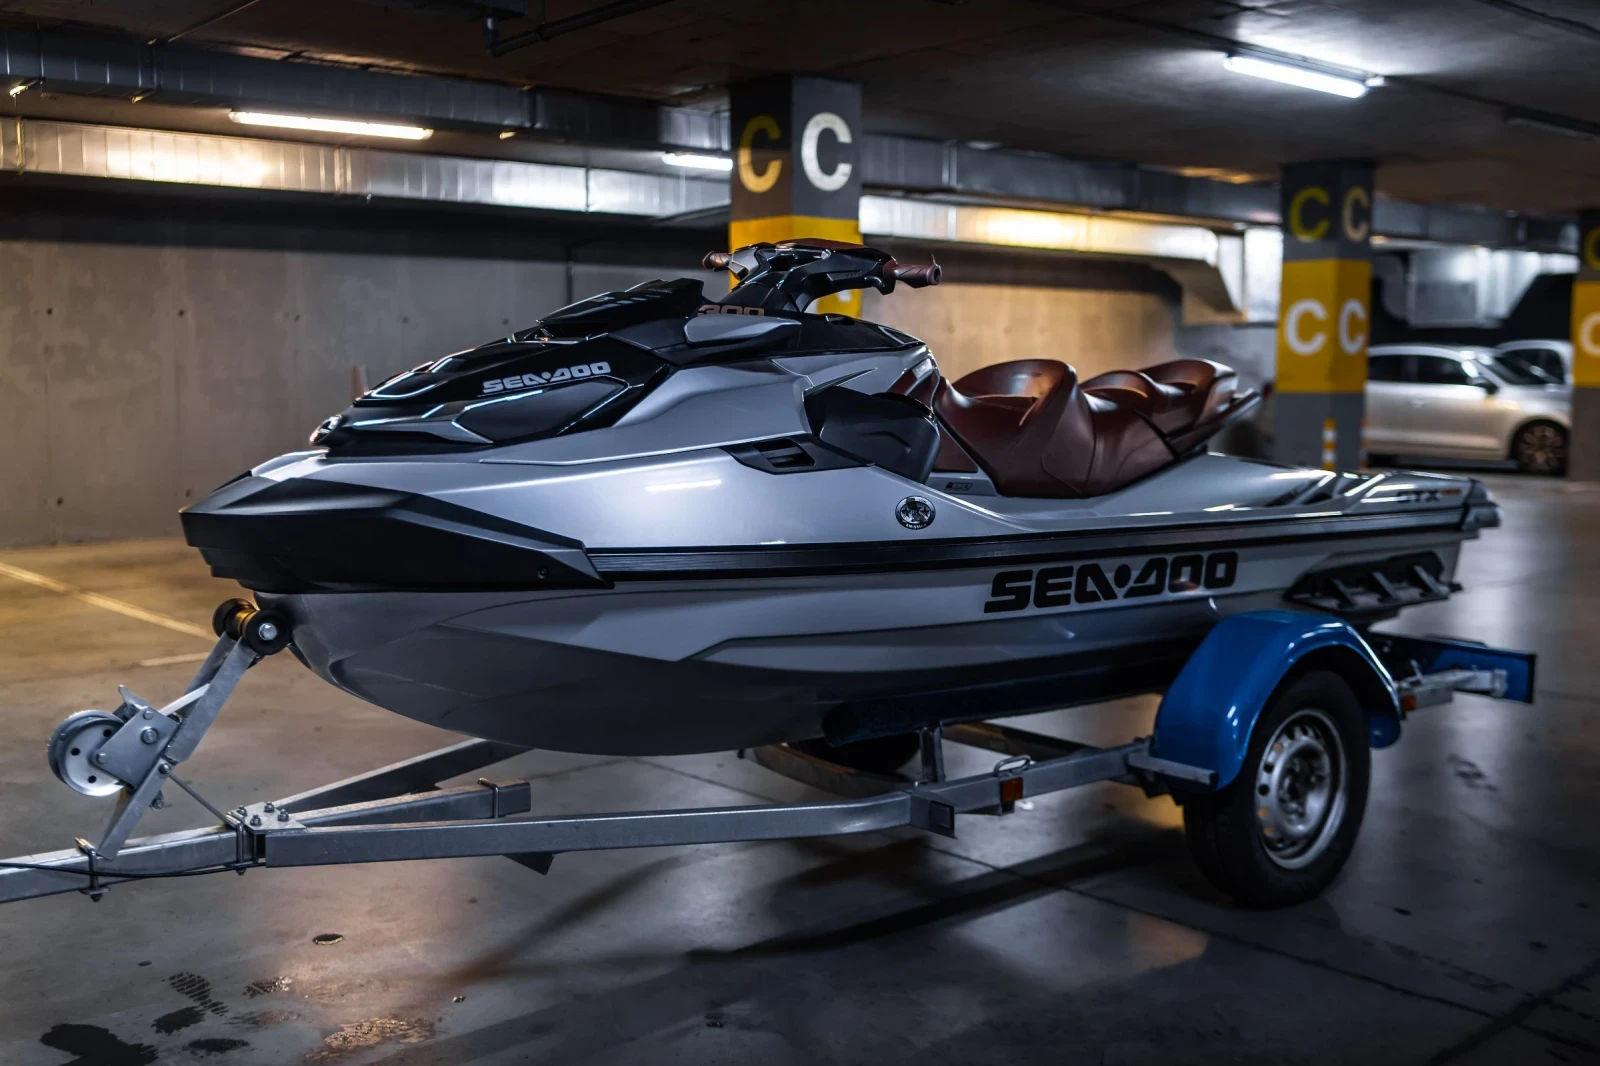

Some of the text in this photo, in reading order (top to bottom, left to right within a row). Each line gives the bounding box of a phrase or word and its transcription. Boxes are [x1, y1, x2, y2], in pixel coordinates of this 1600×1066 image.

[738, 114, 783, 193] C
[801, 112, 852, 192] C
[1289, 186, 1330, 242] C
[1342, 186, 1369, 242] C
[1284, 298, 1327, 355] C
[1339, 298, 1366, 355] C
